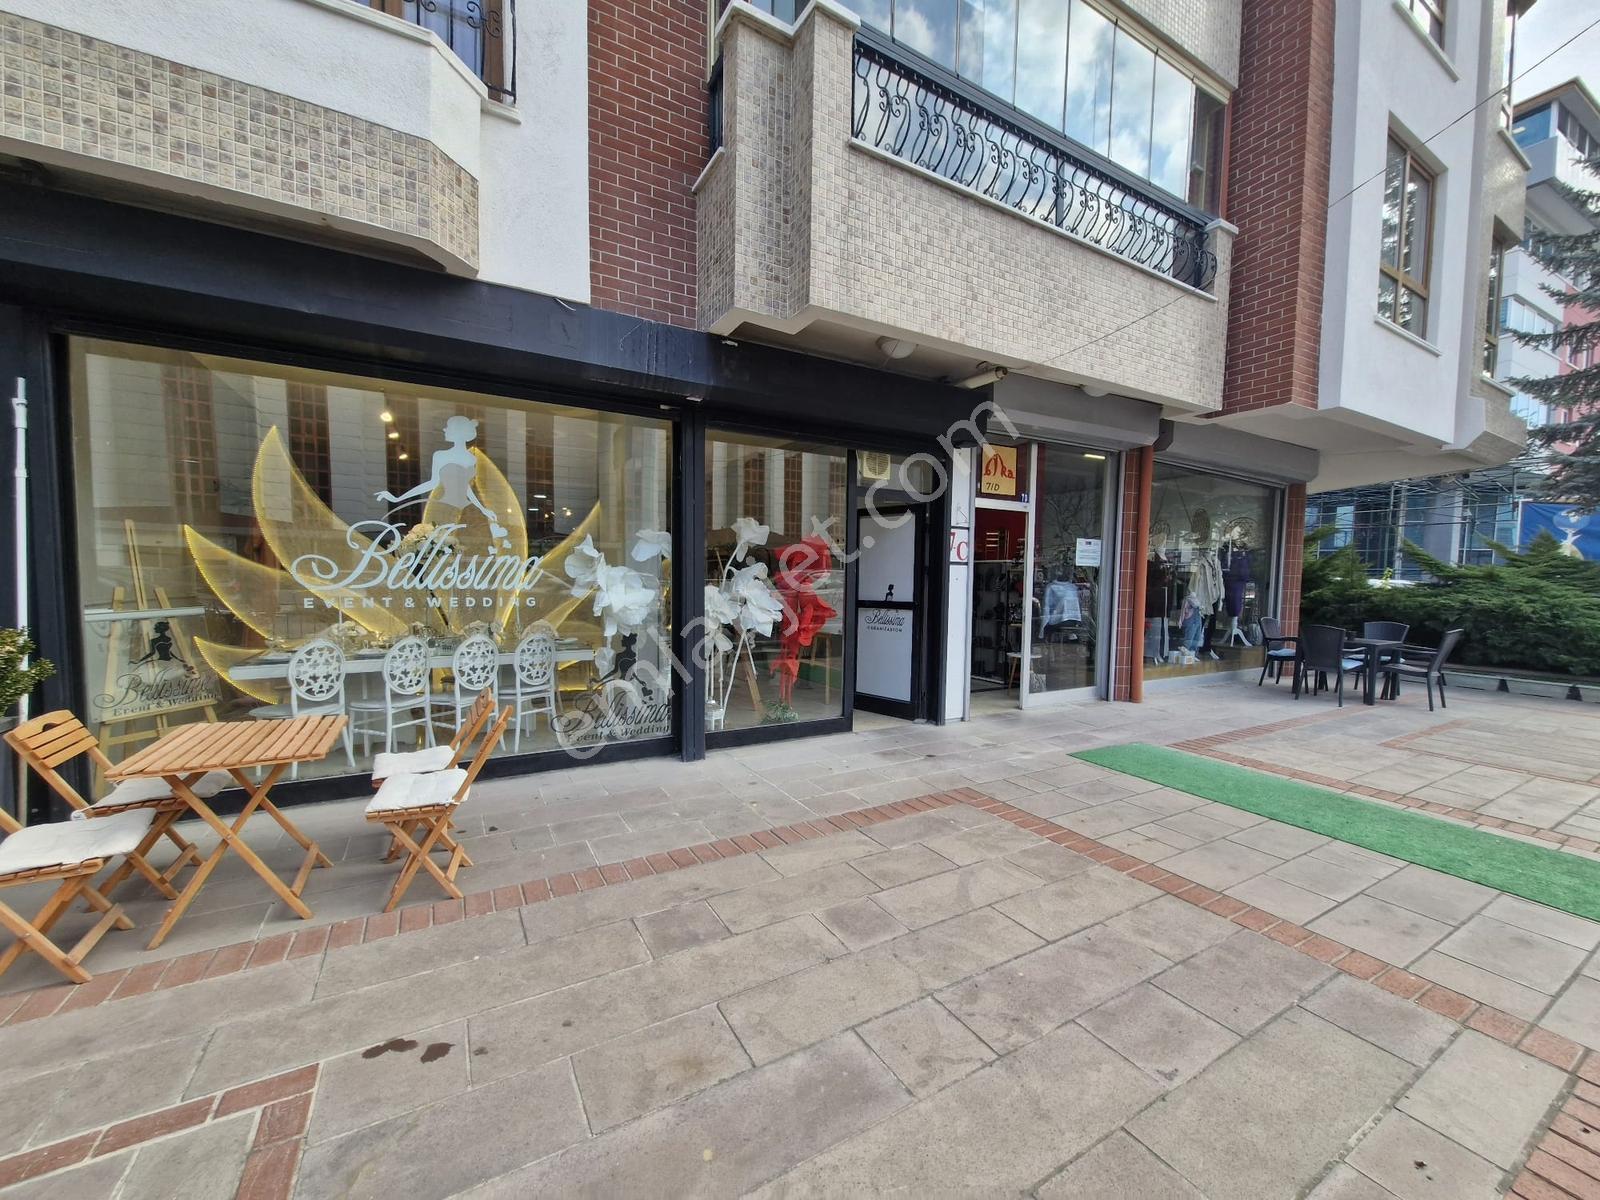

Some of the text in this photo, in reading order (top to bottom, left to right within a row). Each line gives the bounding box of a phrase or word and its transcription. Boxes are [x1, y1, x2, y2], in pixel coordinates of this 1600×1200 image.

[291, 520, 544, 591] Bellissima
[303, 597, 536, 609] EVENT & WEDDING
[567, 731, 604, 744] vent
[620, 723, 670, 738] Wedding
